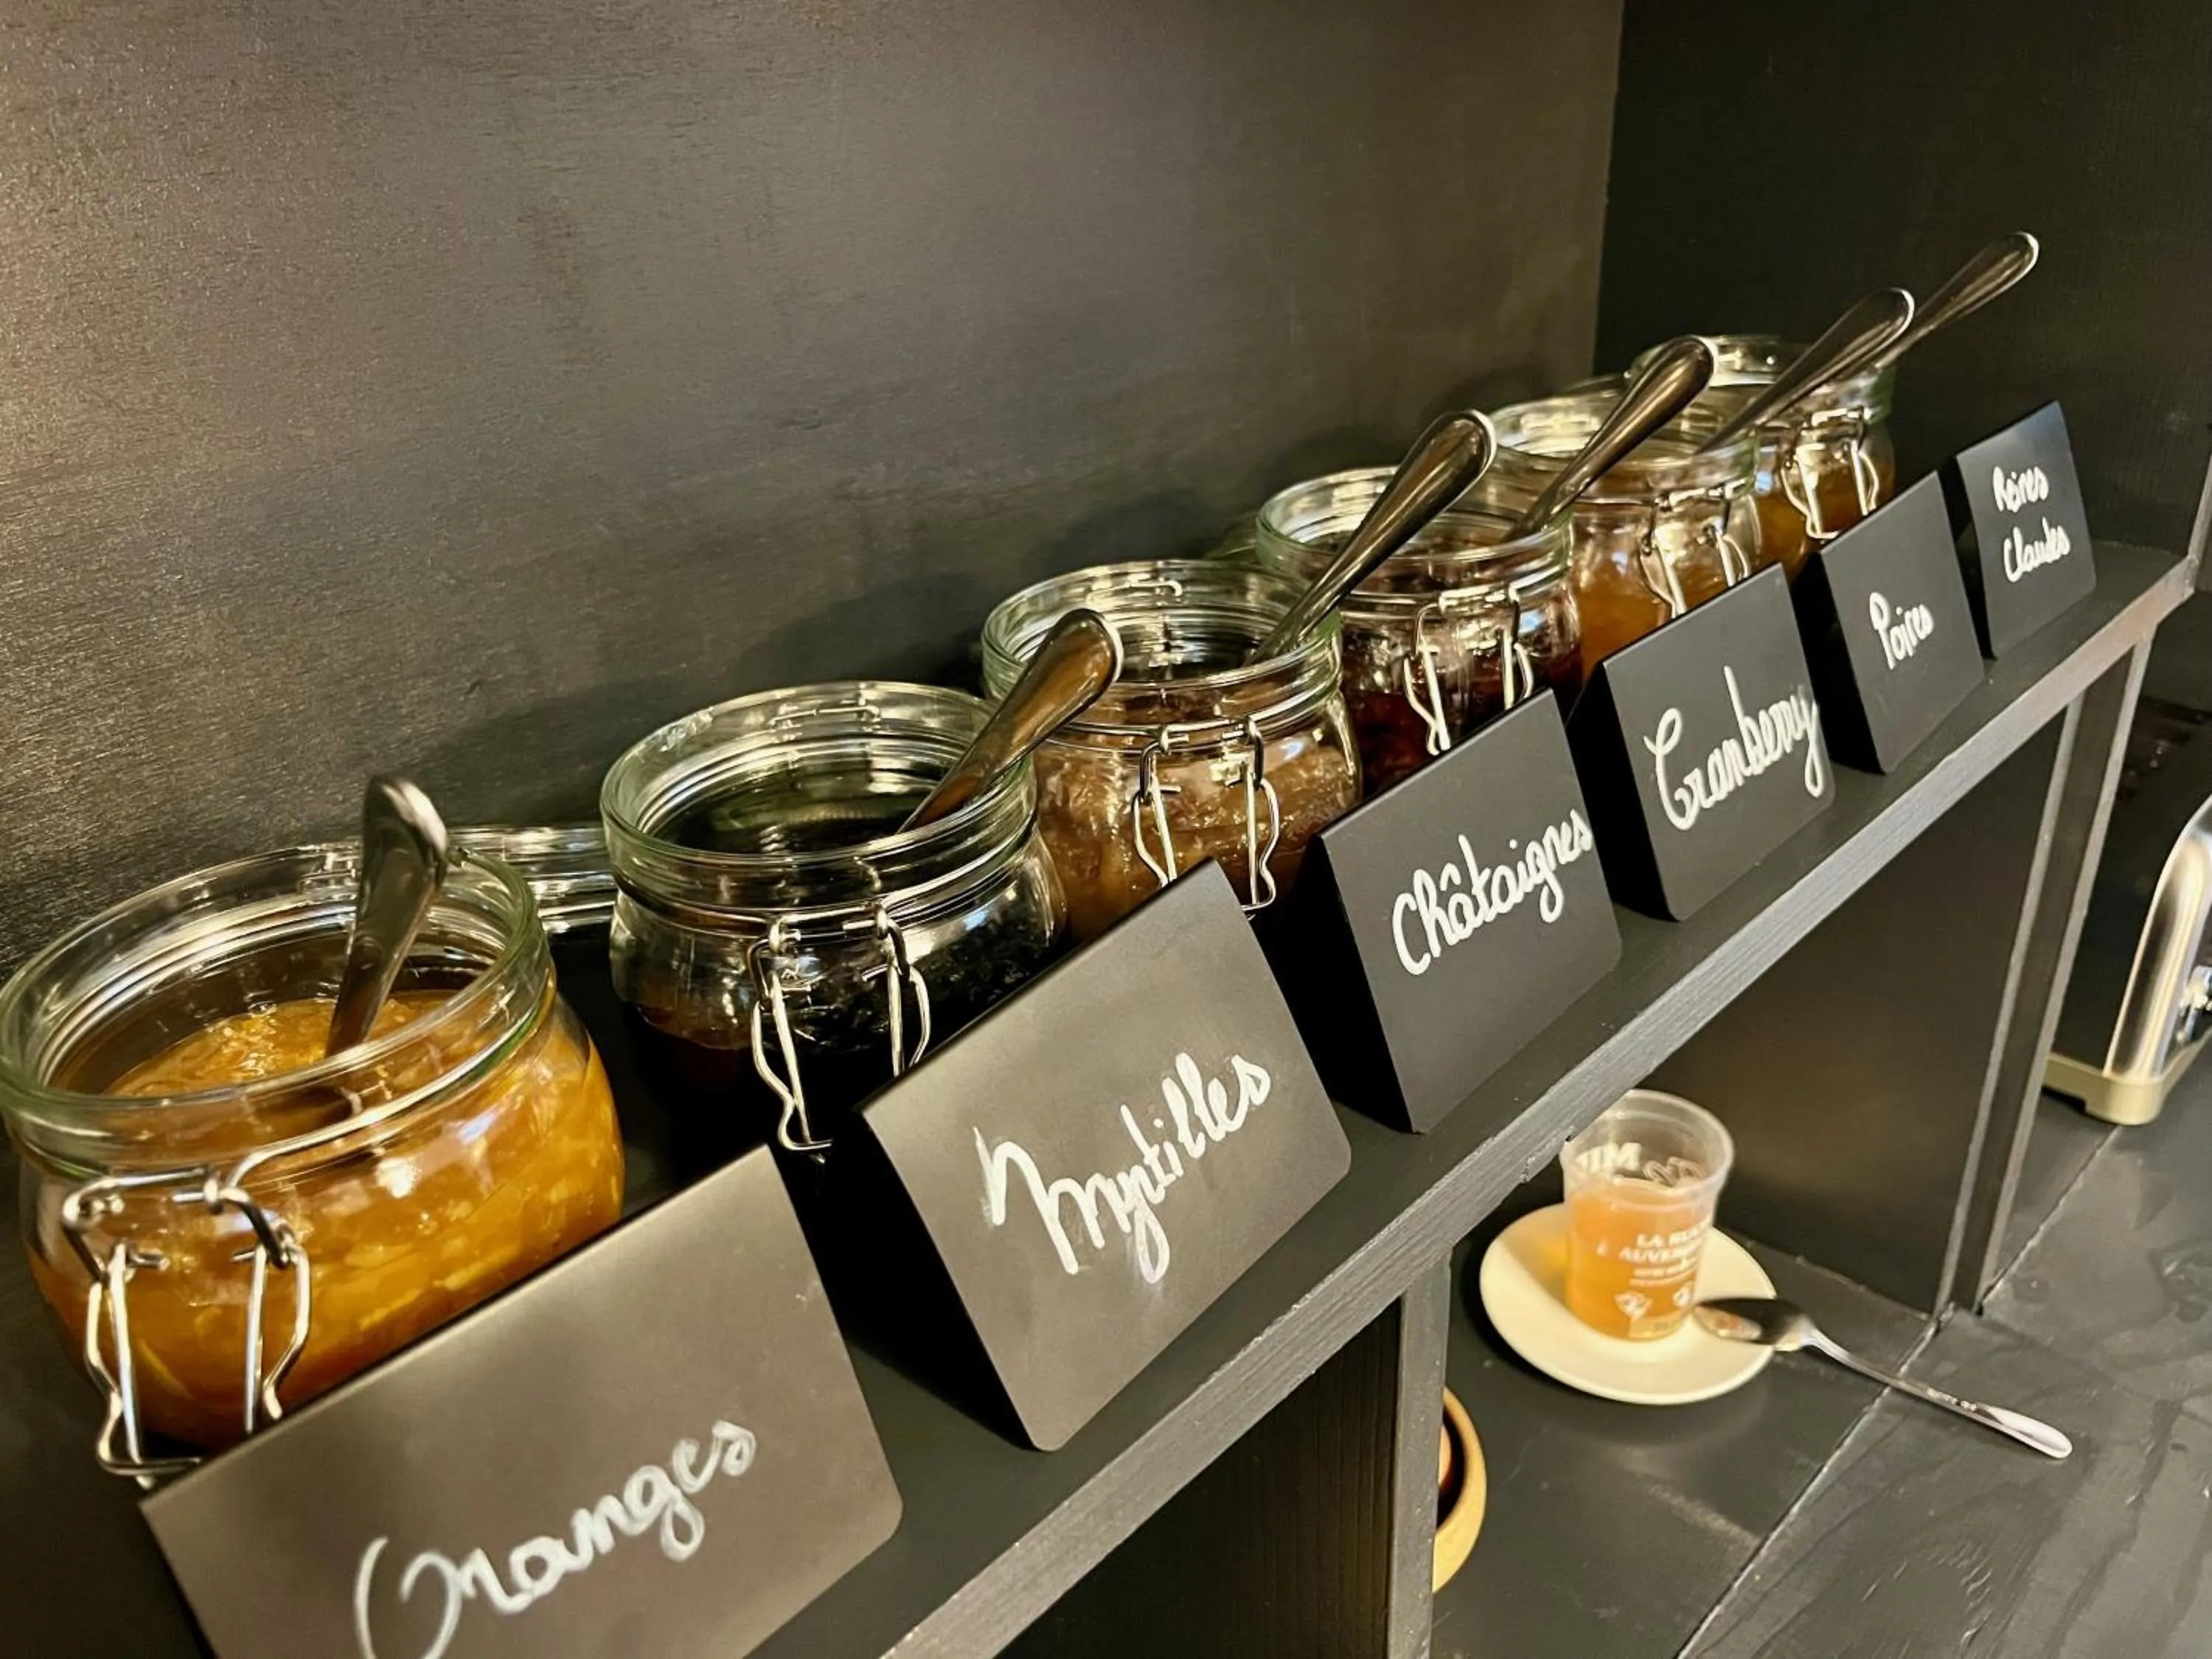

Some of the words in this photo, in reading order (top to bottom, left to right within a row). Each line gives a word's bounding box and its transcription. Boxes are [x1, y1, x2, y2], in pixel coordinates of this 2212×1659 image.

[1993, 466, 2049, 512] Reines
[2003, 517, 2070, 582] Claudes
[1869, 592, 1933, 669] Poires
[1644, 666, 1823, 830] Cranberry
[1392, 809, 1593, 975] Châtaignes
[973, 1052, 1271, 1284] Myrtilles
[357, 1422, 756, 1659] Oranges
